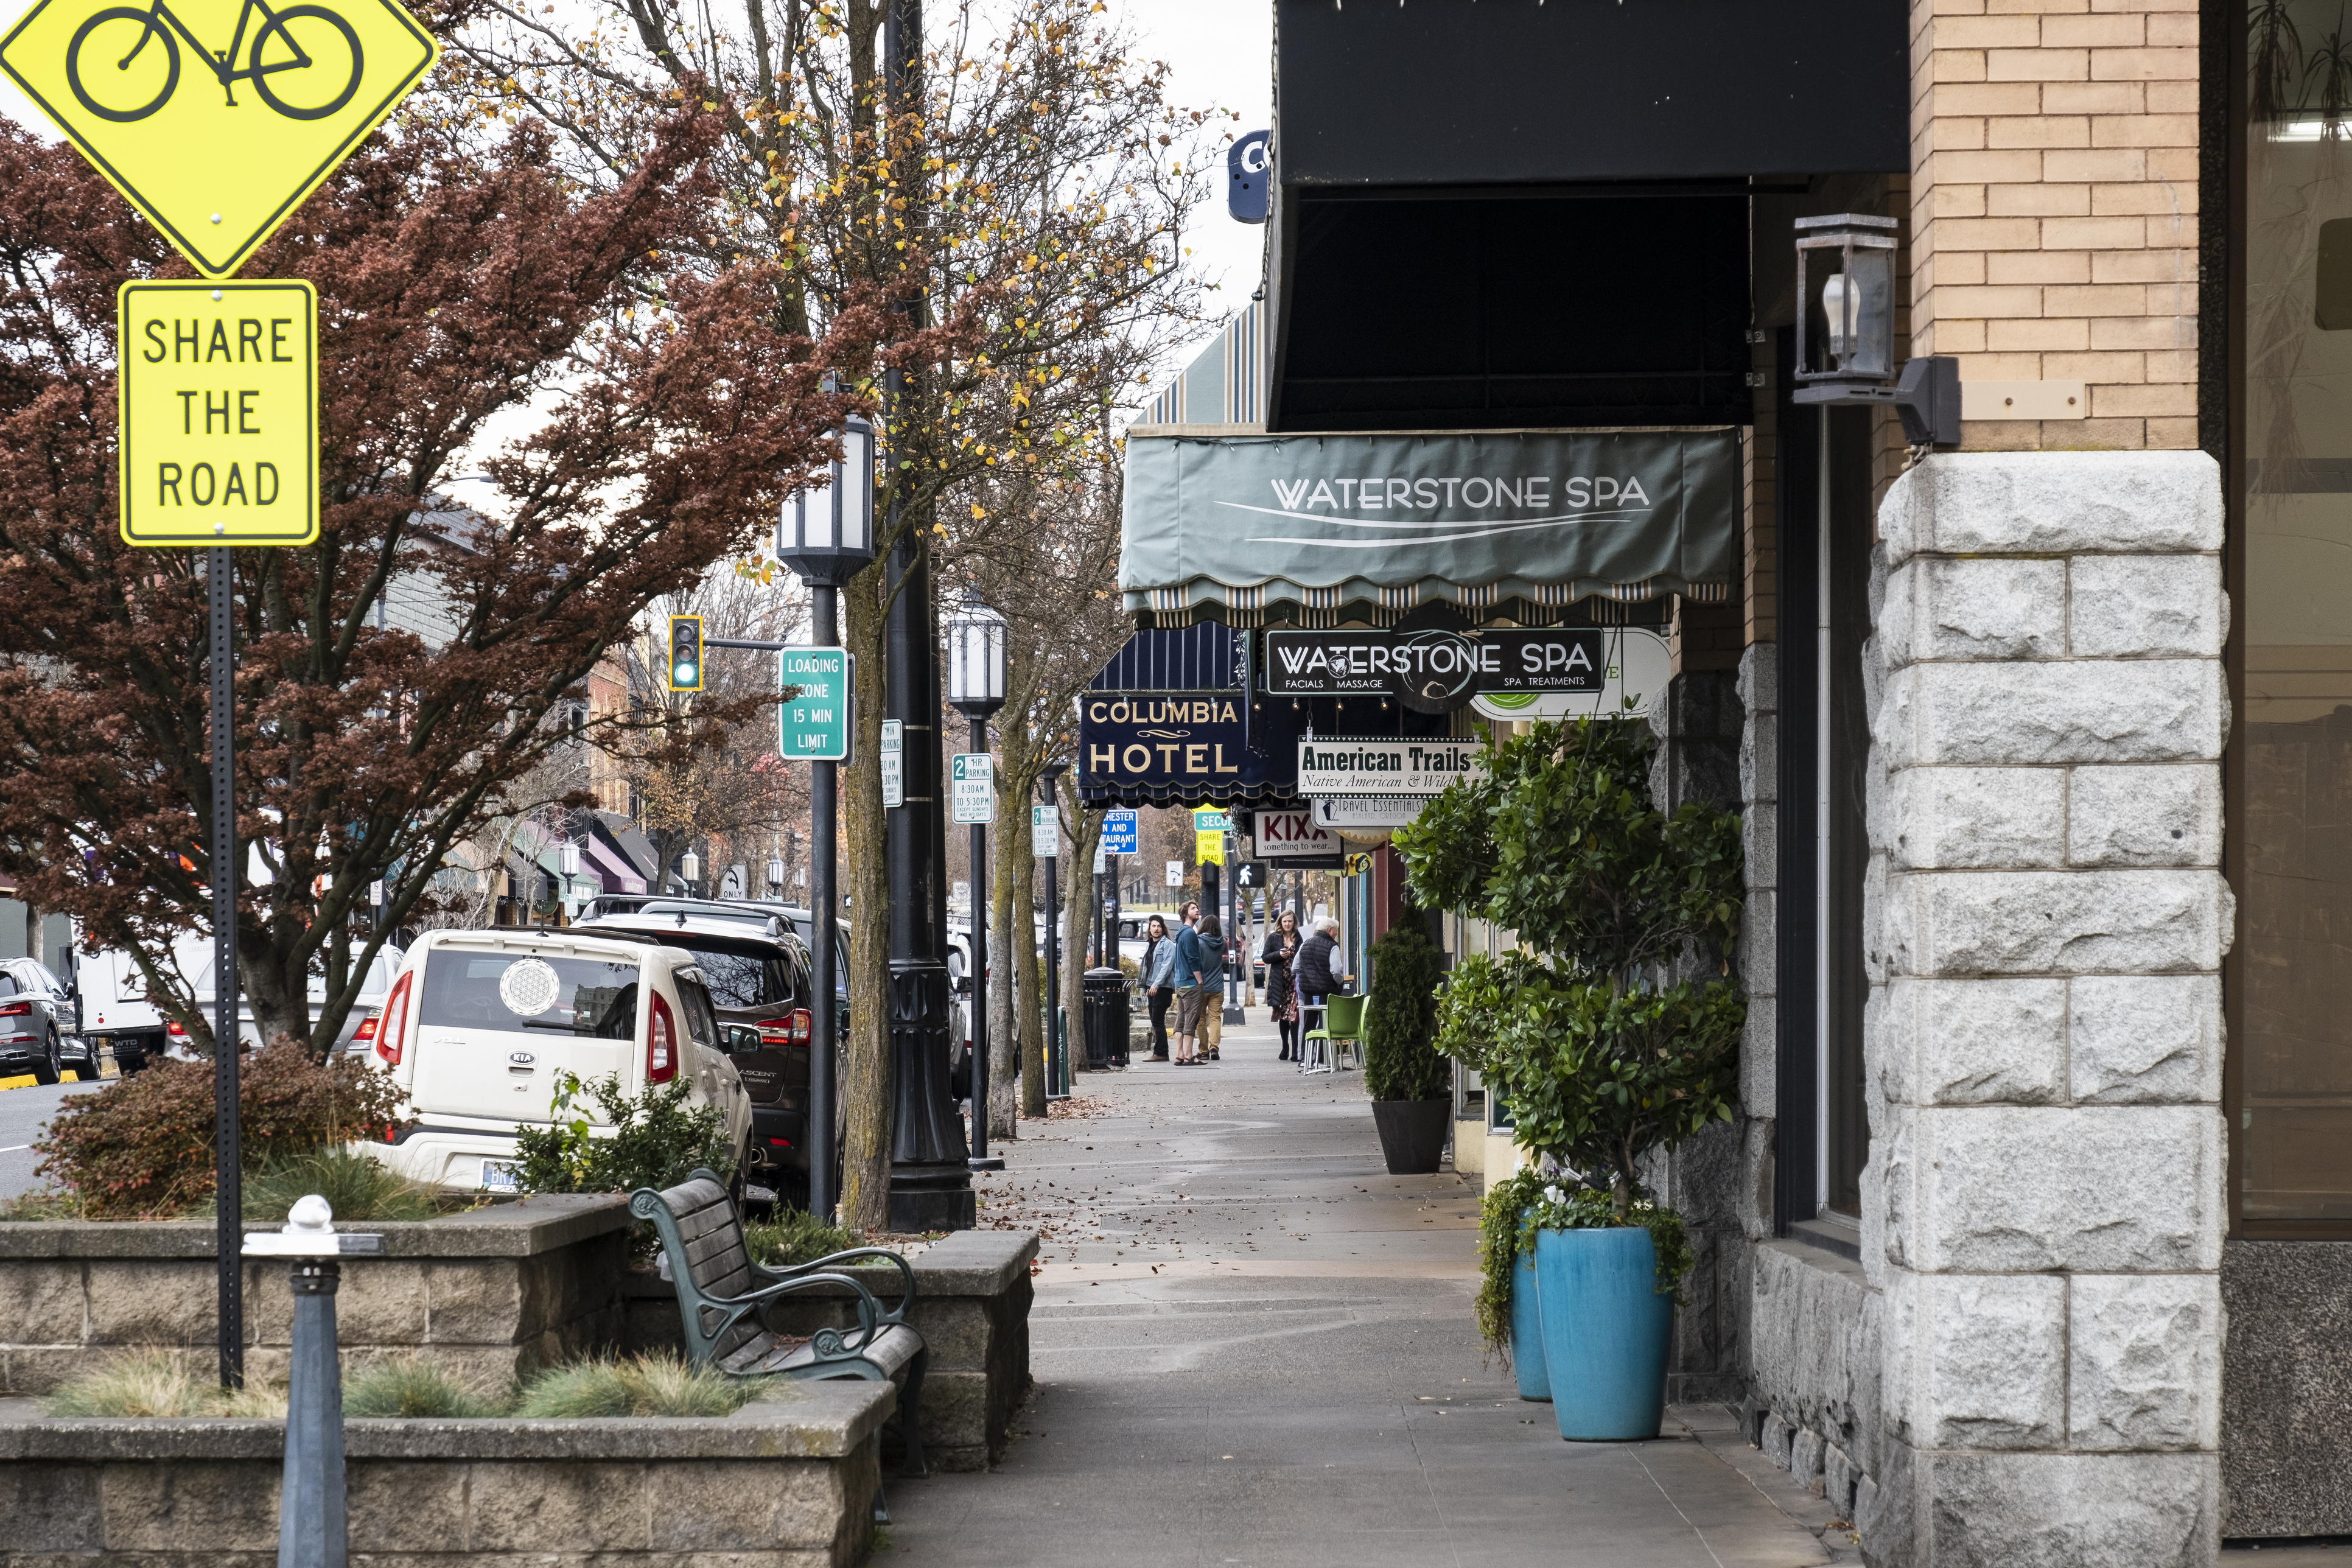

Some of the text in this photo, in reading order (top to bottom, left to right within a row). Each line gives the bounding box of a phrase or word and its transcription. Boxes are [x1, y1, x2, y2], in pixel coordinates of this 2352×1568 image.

[142, 318, 293, 363] SHARE
[177, 390, 261, 434] THE
[159, 461, 279, 506] ROAD
[1271, 476, 1650, 509] WATERSTONE SPA
[1278, 645, 1500, 674] WATERSTONE
[1521, 643, 1592, 672] SPA
[788, 659, 839, 673] LOADING
[1286, 679, 1382, 688] FACIALS MASSAGE
[1504, 676, 1584, 686] SPA TREATMENTS
[797, 684, 828, 698] ZONE
[793, 709, 832, 723] 15 MIN
[1090, 701, 1238, 723] COLUMBIA
[886, 725, 894, 736] MIN
[797, 734, 828, 748] LIMIT
[881, 738, 900, 750] PARKING
[1090, 743, 1238, 773] HOTEL
[1302, 746, 1471, 772] American Trails
[889, 760, 895, 771] AM
[955, 759, 964, 777] 2
[892, 774, 899, 785] PM
[966, 769, 990, 777] PARKING
[1303, 774, 1343, 787] Native
[1345, 774, 1402, 788] American
[1408, 774, 1421, 788] &
[956, 797, 964, 806] TO
[1373, 799, 1421, 812] ESSENTIALS
[1035, 811, 1039, 824] 2
[1111, 824, 1127, 832] AND
[1264, 842, 1298, 852] something
